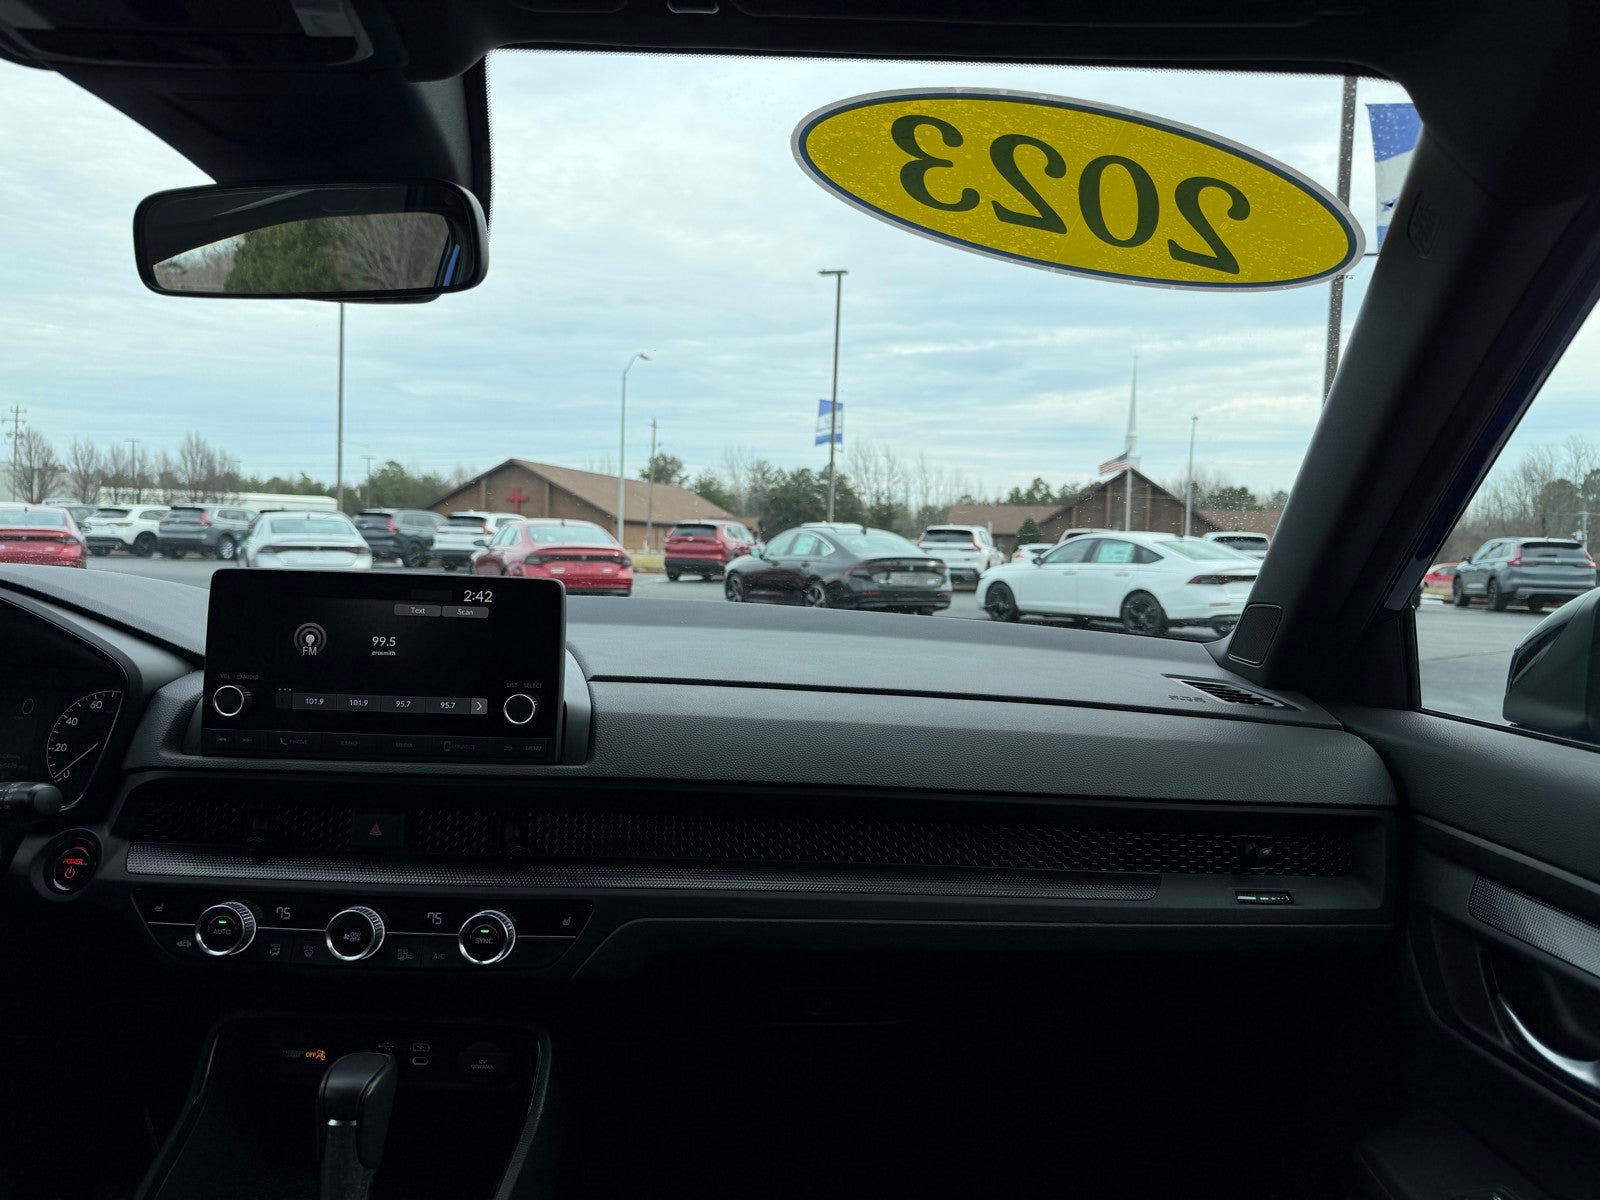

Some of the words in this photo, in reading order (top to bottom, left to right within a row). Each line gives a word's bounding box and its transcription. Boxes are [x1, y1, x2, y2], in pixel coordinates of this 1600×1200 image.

[463, 590, 493, 603] 2:42
[410, 606, 426, 615] Text
[457, 608, 474, 616] Scan
[372, 636, 396, 647] 99.5
[302, 646, 317, 656] FM
[89, 701, 103, 710] 60
[305, 697, 324, 706] 101.9
[349, 698, 369, 707] 101.9
[395, 700, 411, 708] 95.7
[440, 701, 456, 709] 95.7
[65, 716, 78, 726] 40
[54, 743, 67, 752] 20
[275, 906, 291, 920] 75
[427, 911, 442, 925] 75
[213, 928, 231, 936] AUTO
[475, 937, 494, 945] SYNC
